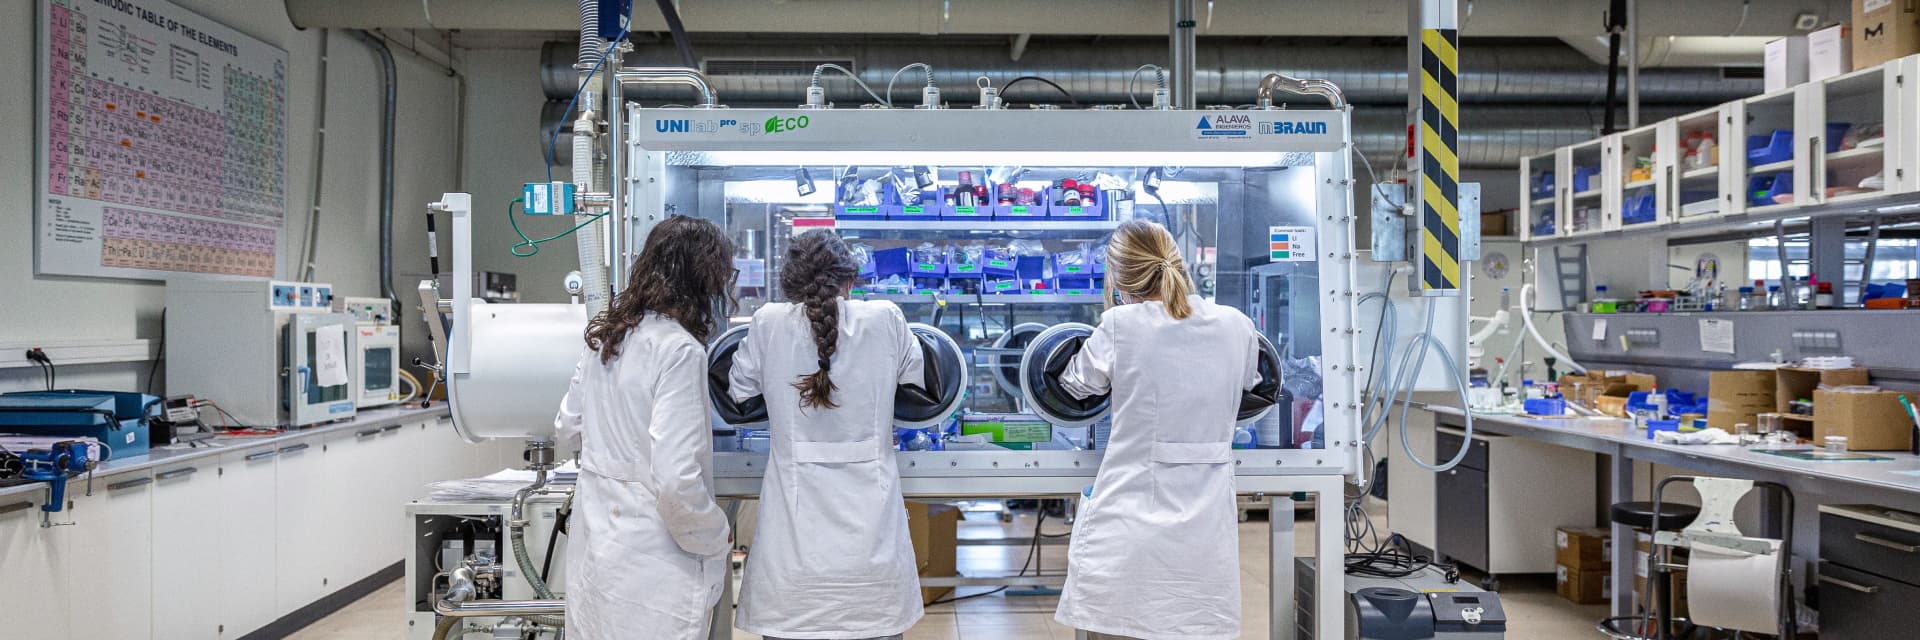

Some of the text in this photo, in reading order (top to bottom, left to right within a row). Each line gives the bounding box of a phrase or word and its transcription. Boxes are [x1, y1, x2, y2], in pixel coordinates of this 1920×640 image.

[94, 0, 238, 57] IODIC TABLE OF THE ELEMENTS
[720, 119, 737, 128] pro
[774, 115, 809, 133] ECO
[1216, 114, 1251, 123] ALAVA
